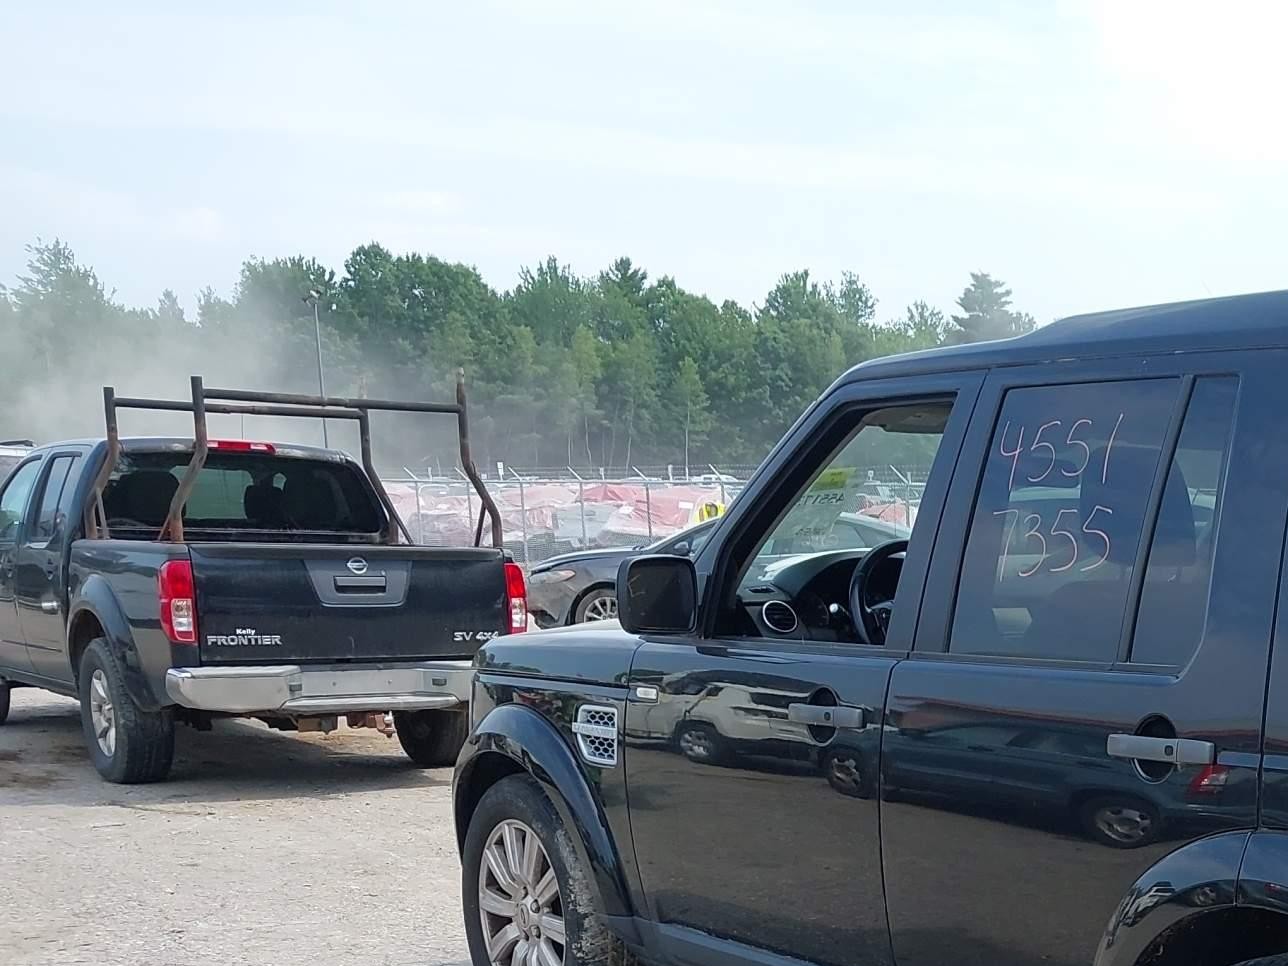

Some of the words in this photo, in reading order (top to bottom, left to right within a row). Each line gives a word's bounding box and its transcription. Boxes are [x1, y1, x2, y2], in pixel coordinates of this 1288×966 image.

[1000, 413, 1124, 491] 4551
[993, 505, 1113, 583] 7355
[207, 635, 282, 646] FRONTIER
[453, 631, 473, 641] SV
